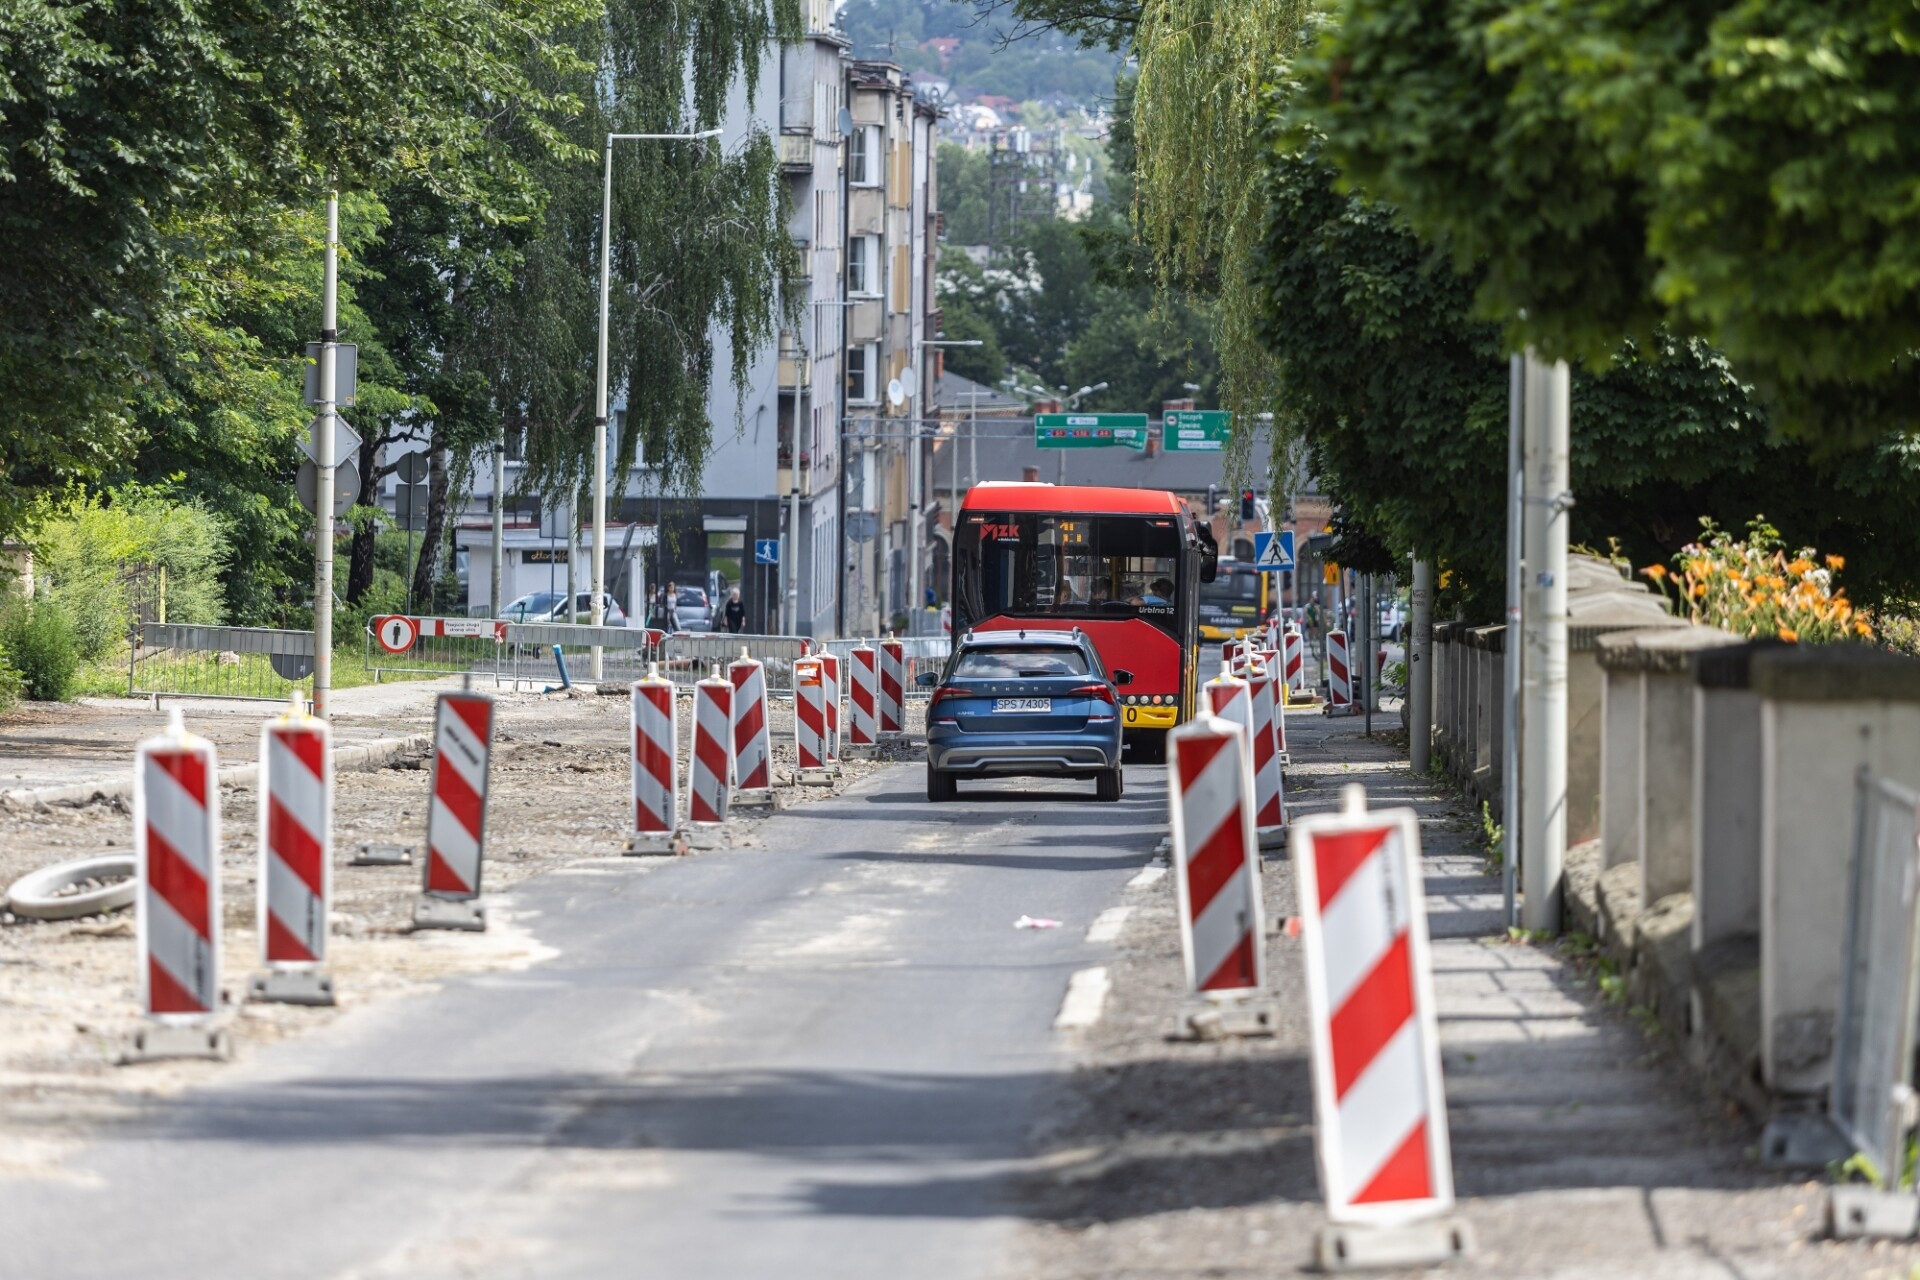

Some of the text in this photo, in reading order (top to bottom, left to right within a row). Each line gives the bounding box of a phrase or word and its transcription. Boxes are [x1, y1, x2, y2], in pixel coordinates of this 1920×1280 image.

[980, 524, 1019, 541] MZK
[1138, 606, 1165, 614] Urbino
[997, 699, 1050, 709] SPS 74305
